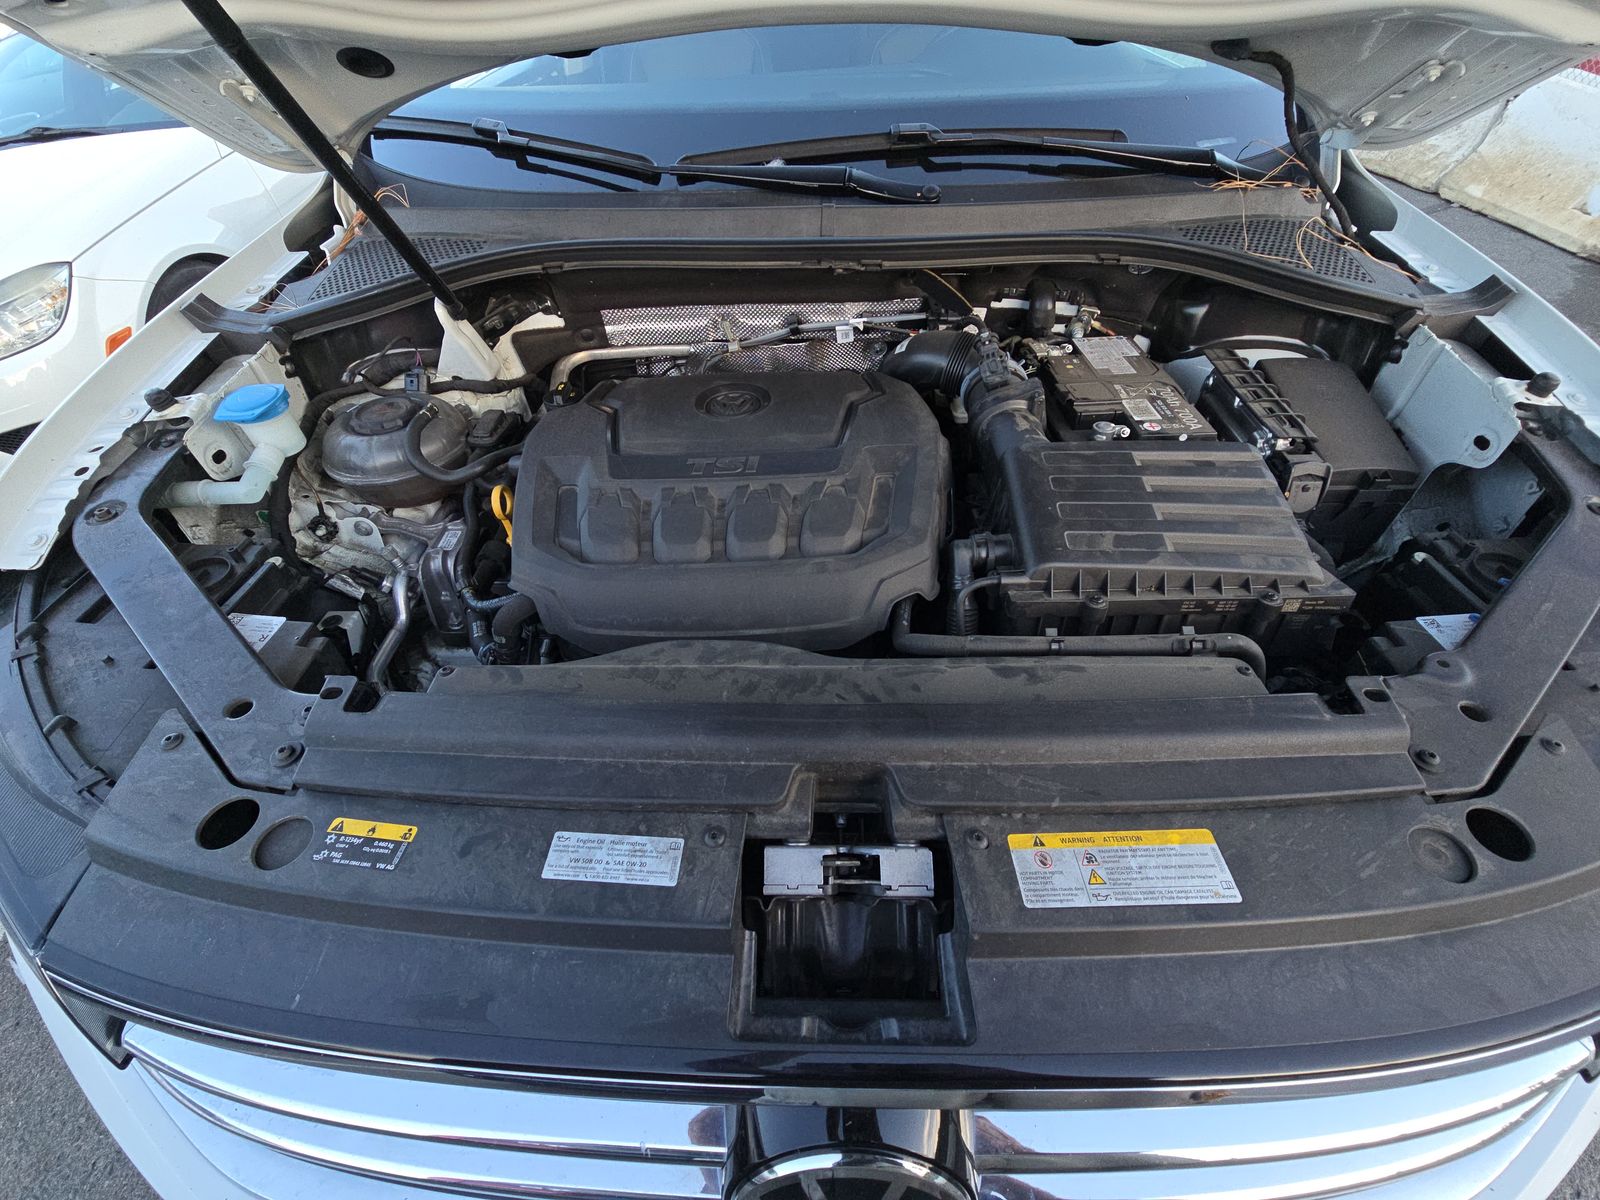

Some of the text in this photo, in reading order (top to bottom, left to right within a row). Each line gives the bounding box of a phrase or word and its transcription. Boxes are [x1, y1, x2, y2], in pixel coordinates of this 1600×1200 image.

[1174, 408, 1202, 430] 700A
[685, 456, 760, 475] TSI
[576, 837, 596, 845] Engine
[1060, 836, 1095, 844] WARNING
[1103, 835, 1143, 843] ATTENTION
